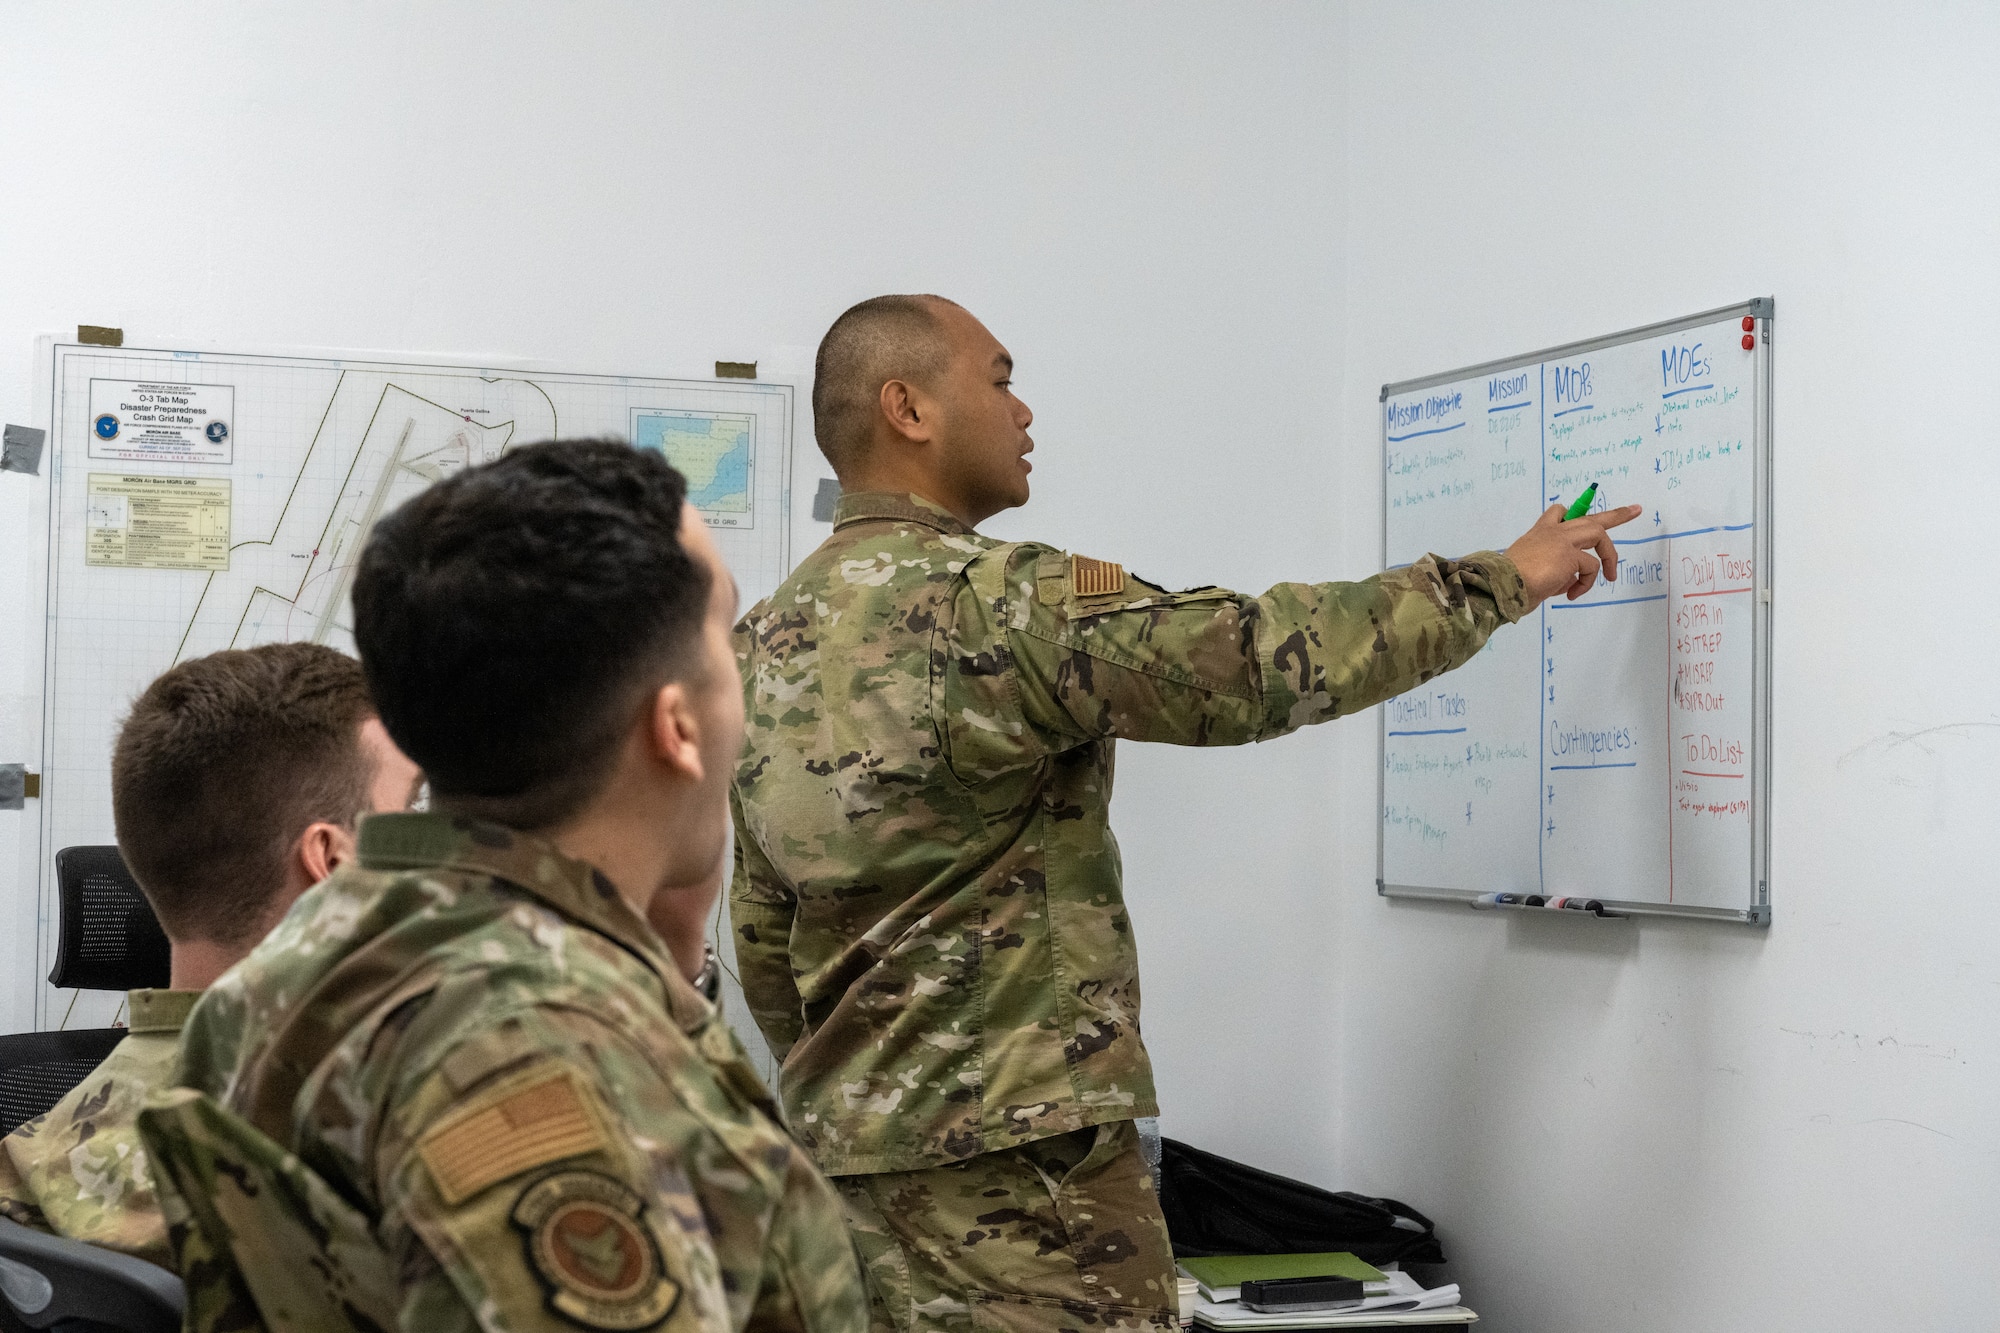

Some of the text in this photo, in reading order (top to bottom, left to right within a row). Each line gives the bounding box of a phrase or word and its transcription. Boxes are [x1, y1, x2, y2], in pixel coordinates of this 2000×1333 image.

[139, 394, 188, 405] O-3 Tab Map
[1487, 373, 1527, 402] Mission
[120, 403, 206, 415] Disaster Preparedness
[133, 413, 193, 424] Crash Grid Map
[1387, 388, 1463, 431] Mission Objective
[1682, 553, 1752, 592] Daily Tasks
[1388, 691, 1433, 724] Tactical
[1705, 692, 1726, 712] Out
[1681, 734, 1745, 765] To Do List
